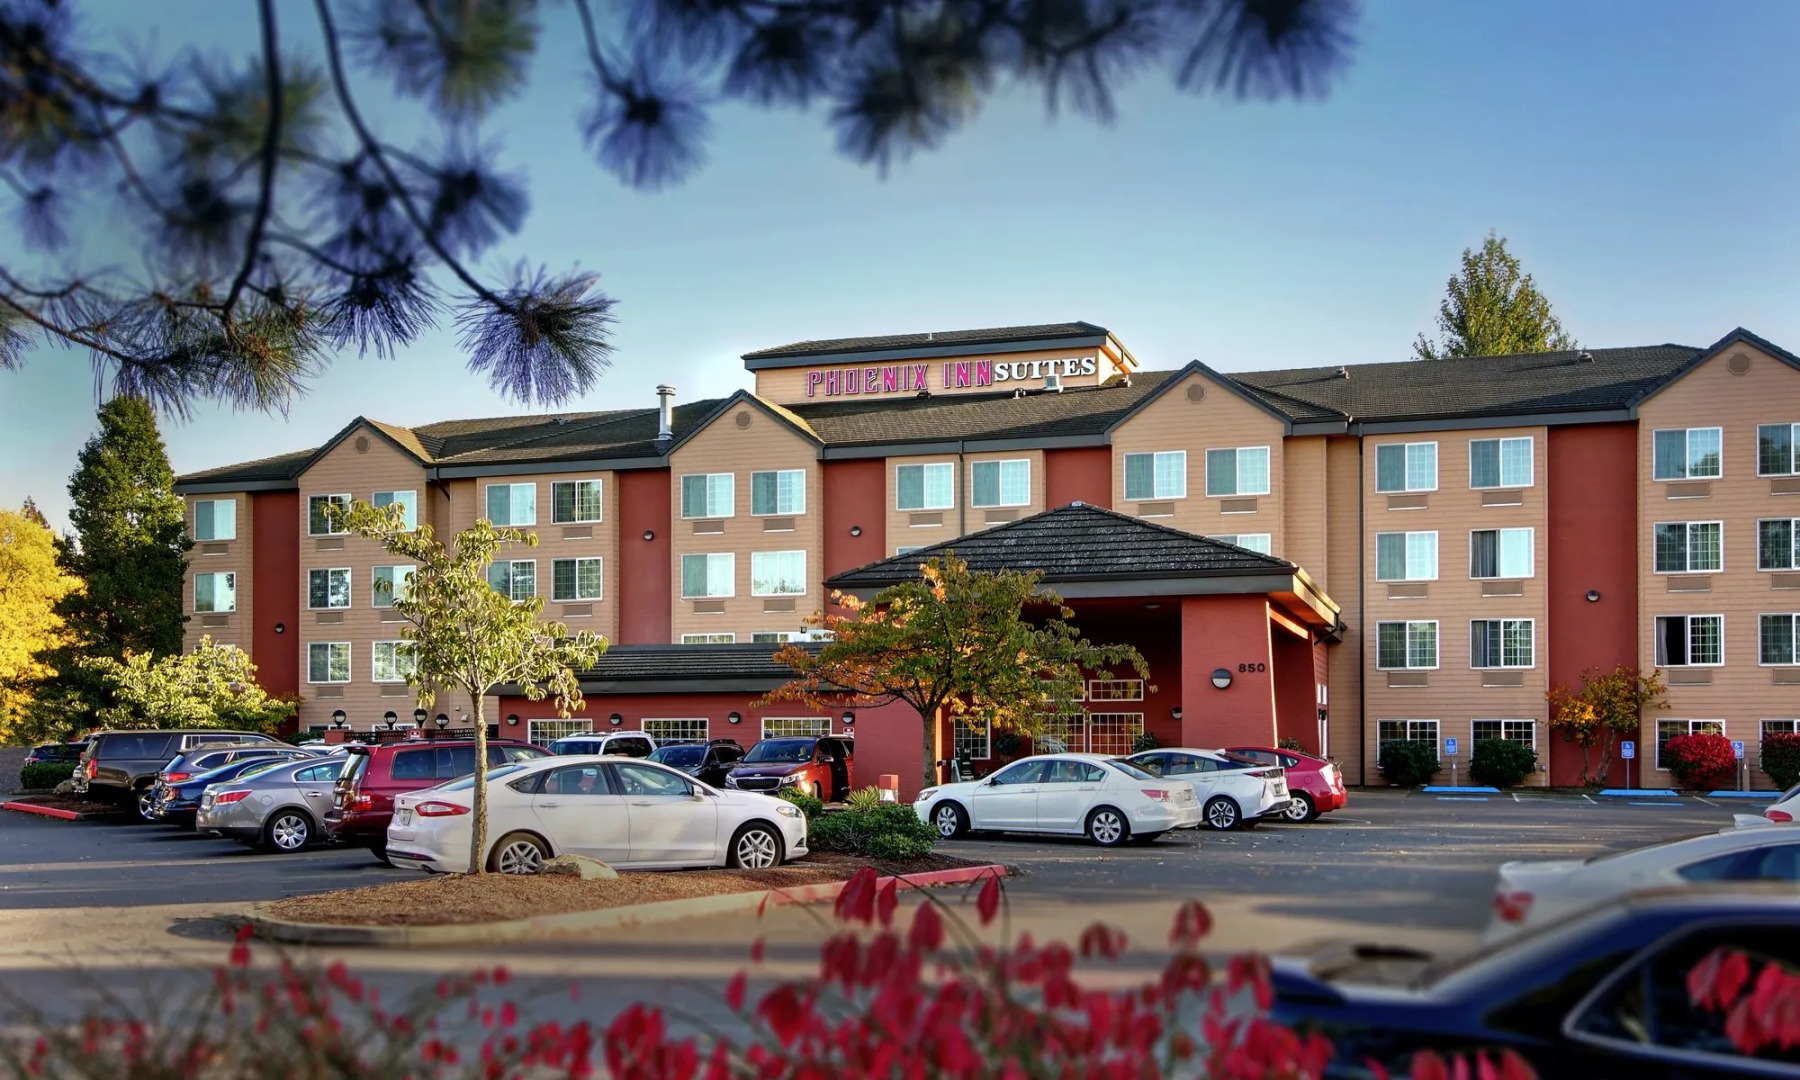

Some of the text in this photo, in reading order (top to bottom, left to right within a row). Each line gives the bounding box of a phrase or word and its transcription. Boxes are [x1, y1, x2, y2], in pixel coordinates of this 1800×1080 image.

[806, 356, 1096, 396] PHOENIX INN SUITES
[1238, 663, 1265, 673] 850
